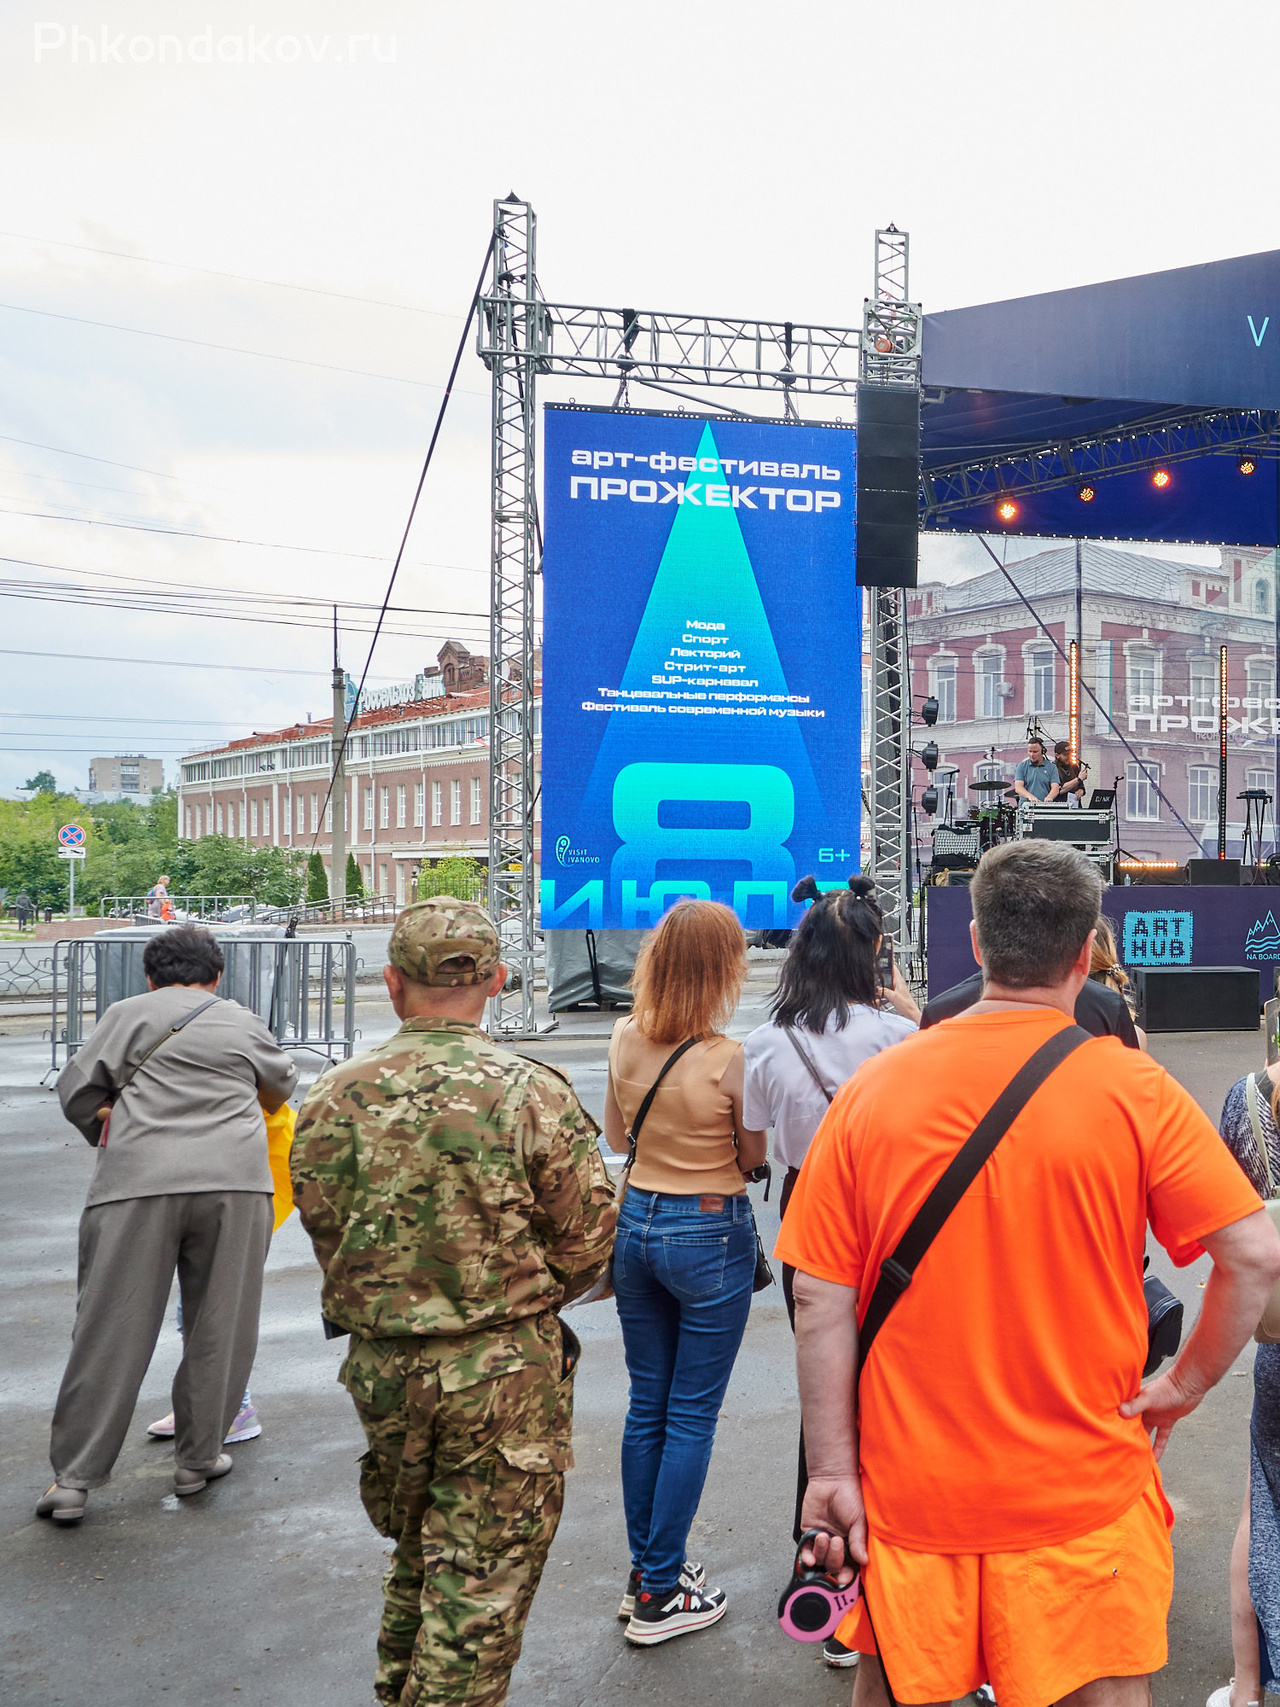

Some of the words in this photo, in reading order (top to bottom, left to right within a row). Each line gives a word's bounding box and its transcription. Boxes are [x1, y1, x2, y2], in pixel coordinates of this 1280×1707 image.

[571, 449, 842, 482] арт-фестиваль
[570, 475, 842, 514] ПРОЖЕКТОР
[686, 620, 726, 632] Мода
[682, 634, 730, 646] Спорт
[669, 647, 741, 660] Лекторий
[664, 661, 747, 675] Стрит-арт
[652, 675, 759, 688] SUP-карнавал
[597, 687, 707, 700] Танцевальные
[708, 692, 810, 704] перформансы
[581, 701, 667, 713] Фестиваль
[668, 705, 767, 716] современной
[768, 708, 826, 718] музыки
[610, 762, 797, 908] 8
[567, 856, 600, 864] IVANOVO
[568, 848, 588, 856] VISIT
[818, 847, 851, 863] 6+
[541, 879, 851, 929] ИЮЛ
[1131, 917, 1185, 937] ART
[1131, 938, 1186, 959] HUB
